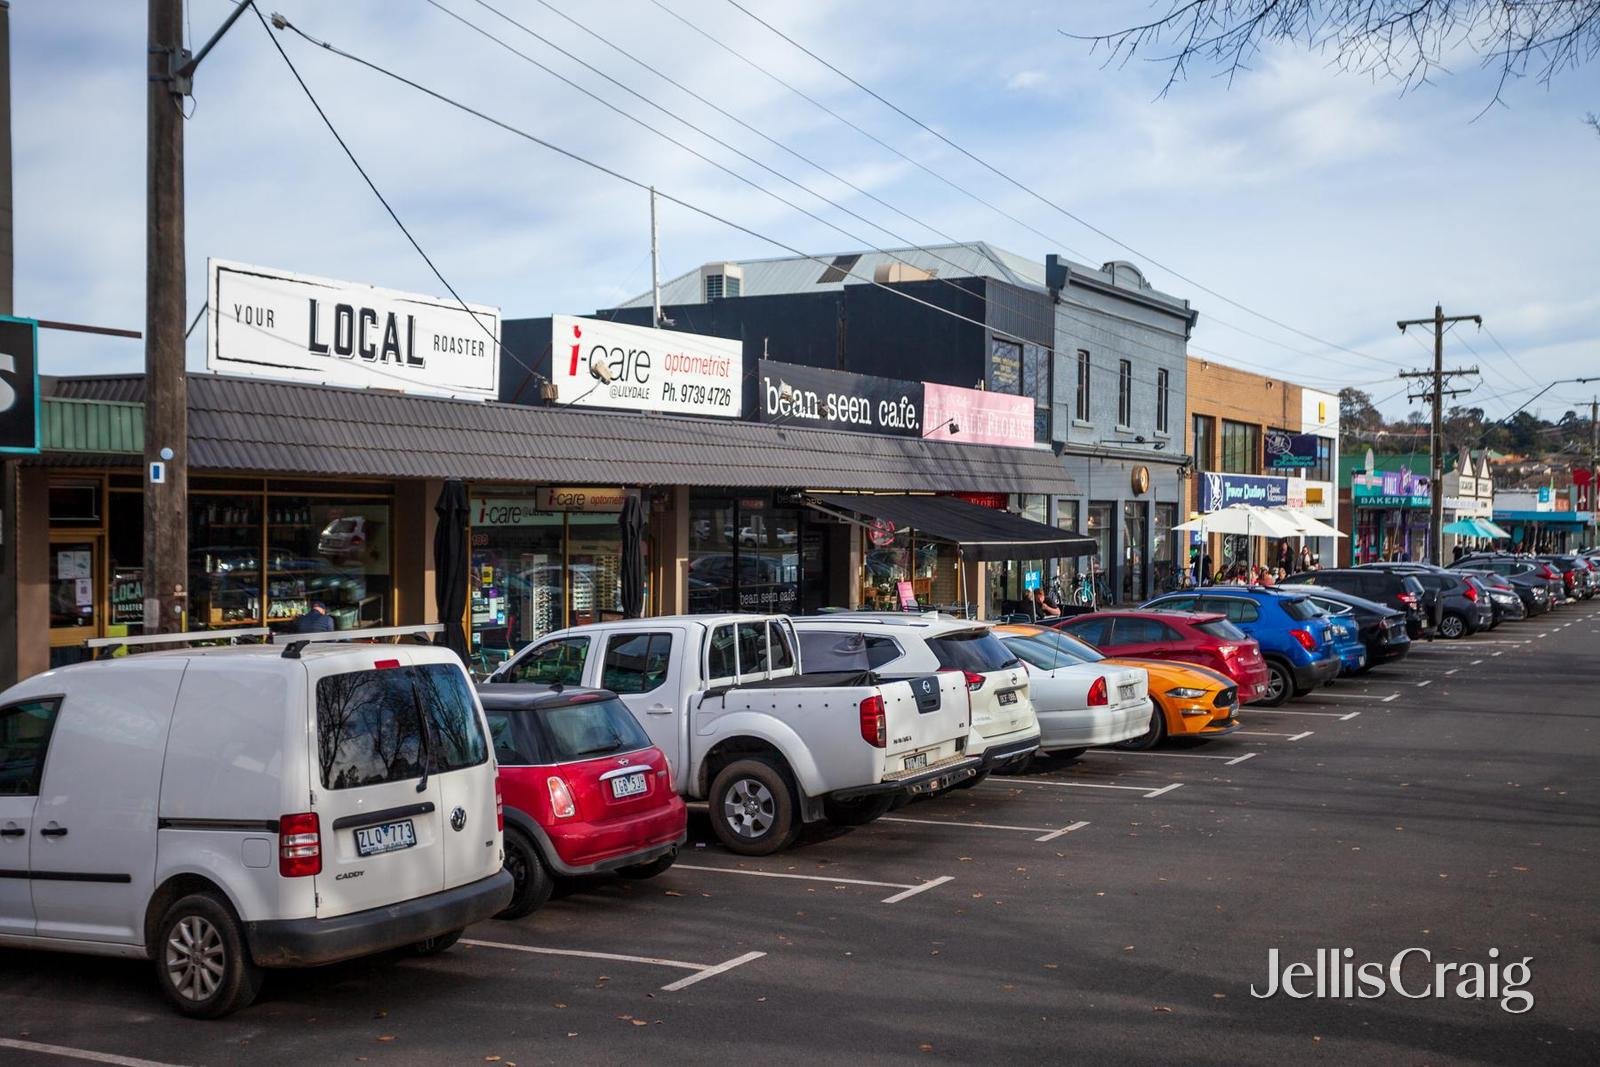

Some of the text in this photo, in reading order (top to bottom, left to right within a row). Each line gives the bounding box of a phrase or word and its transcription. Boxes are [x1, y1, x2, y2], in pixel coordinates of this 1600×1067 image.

[235, 298, 485, 369] YOUR LOCAL ROASTER
[569, 325, 731, 384] i-care optometrist
[609, 384, 651, 400] @LILYDALE
[662, 381, 732, 407] Ph. 9739 4726
[827, 392, 873, 425] seen
[878, 395, 920, 430] cafe.
[548, 488, 585, 506] i-care
[1360, 496, 1407, 505] BAKERY
[479, 497, 521, 524] i-care
[389, 823, 413, 842] 773
[335, 870, 365, 881] CADDY
